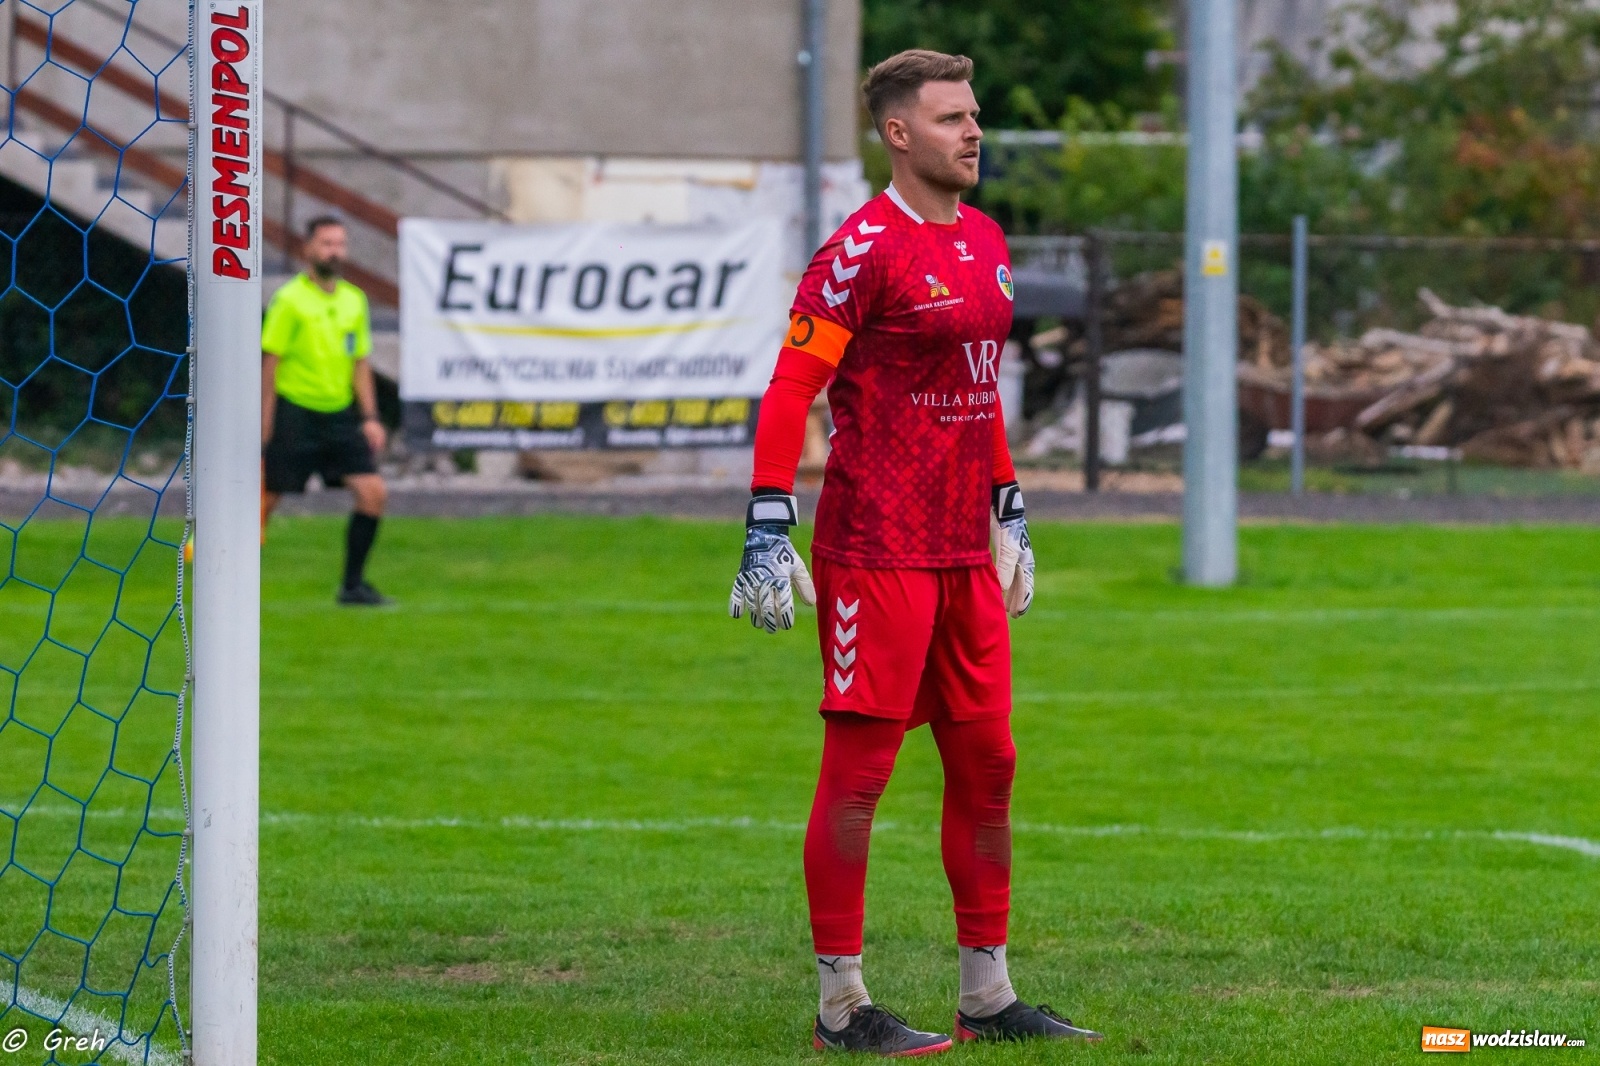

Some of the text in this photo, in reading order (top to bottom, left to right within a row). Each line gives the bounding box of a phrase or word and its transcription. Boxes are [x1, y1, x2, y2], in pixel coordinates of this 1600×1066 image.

[210, 5, 250, 280] PESMENPOL
[438, 243, 747, 312] Eurocar
[962, 340, 998, 384] VR
[910, 392, 963, 407] VILLA
